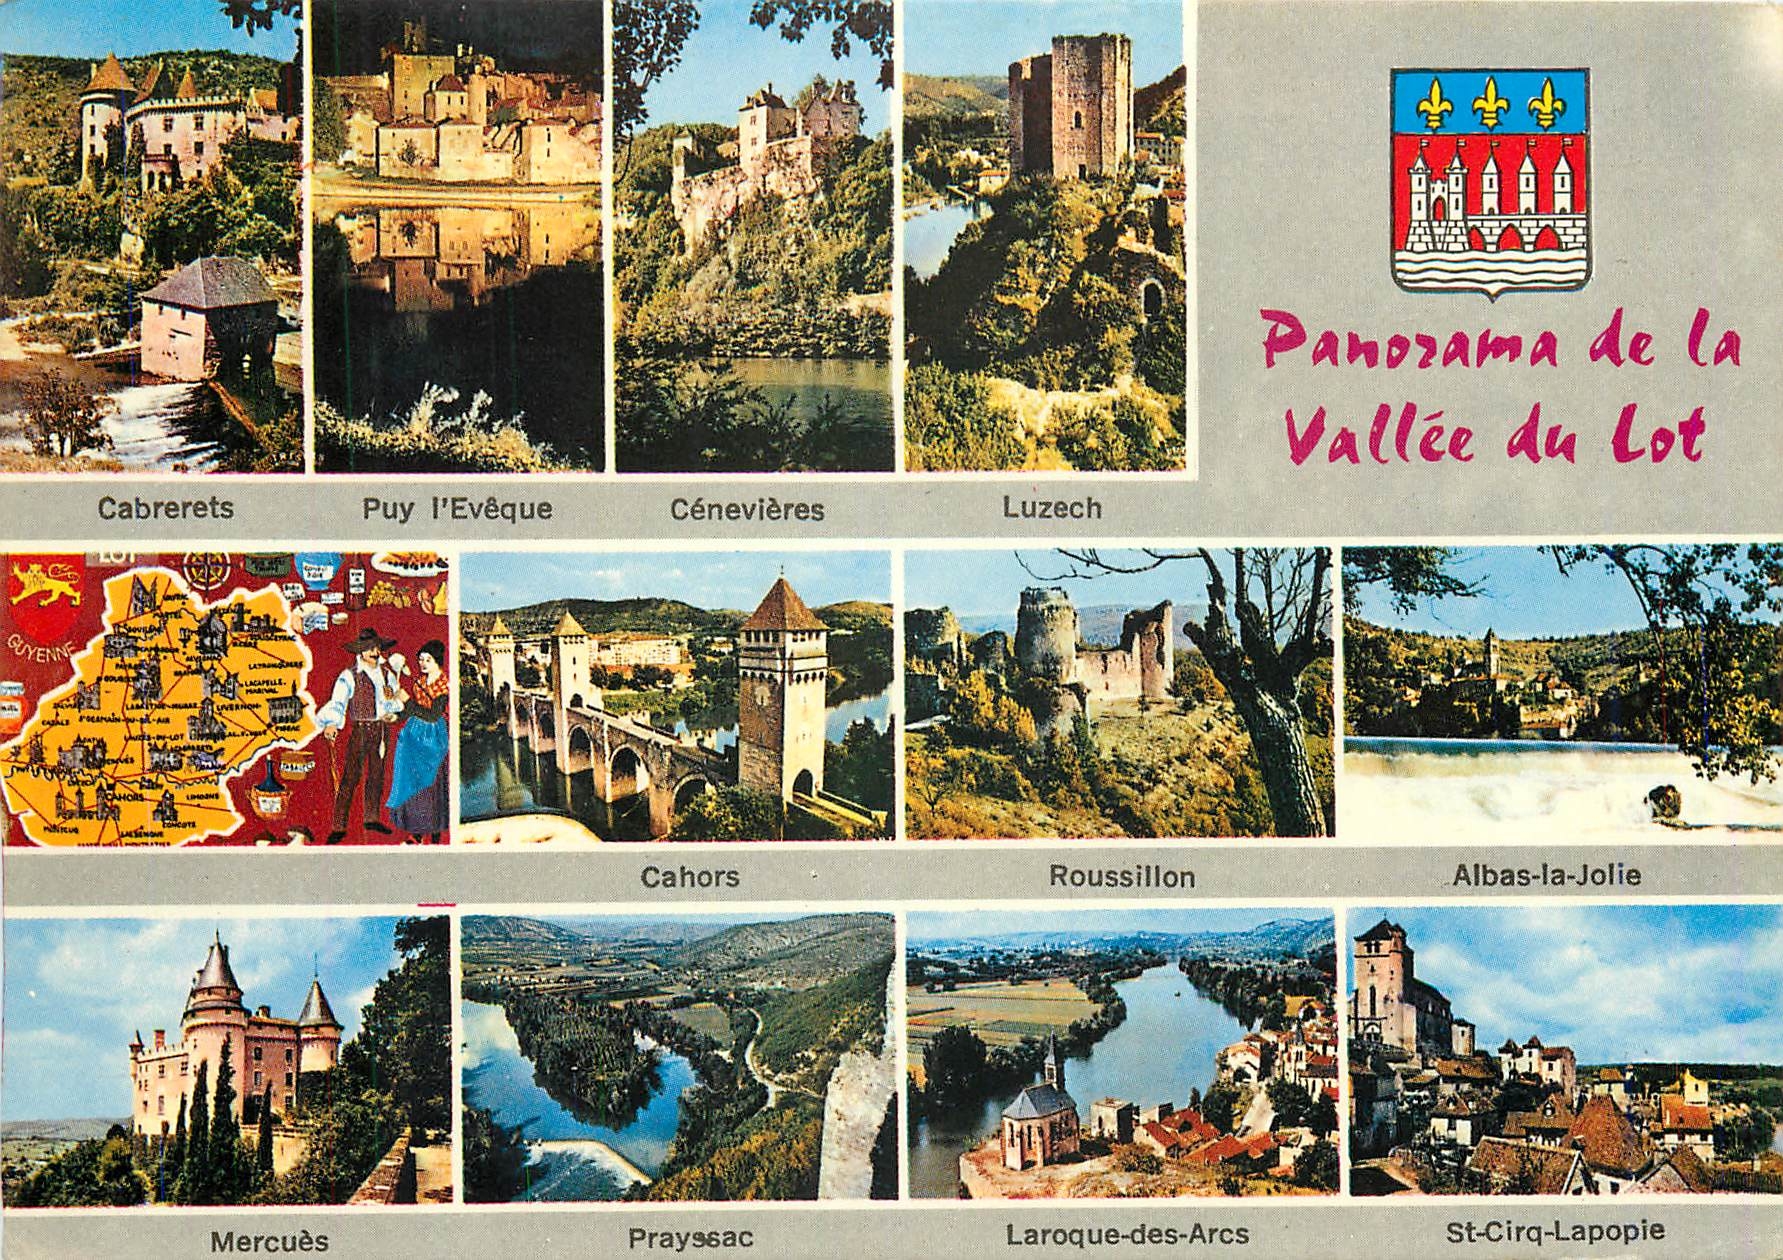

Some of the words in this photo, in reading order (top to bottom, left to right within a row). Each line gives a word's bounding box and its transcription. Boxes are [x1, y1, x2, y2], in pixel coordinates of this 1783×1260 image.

[1261, 310, 1556, 368] Panorama
[1590, 308, 1653, 367] de
[1688, 308, 1740, 366] la
[1286, 403, 1474, 464] Vallée
[1508, 403, 1576, 463] du
[1613, 404, 1705, 463] Lot
[99, 496, 233, 520] Cabrerets
[364, 498, 414, 524] Puy
[433, 497, 552, 525] l'Evêque
[672, 497, 824, 521] Cénevières
[1004, 496, 1101, 519] Luzech
[641, 866, 739, 888] Cahors
[1051, 864, 1194, 888] Roussillon
[1455, 863, 1641, 886] Albas-la-Jolie
[212, 1230, 328, 1252] Mercuès
[630, 1228, 753, 1253] Prayssac
[1007, 1223, 1249, 1248] Laroque-des-Arcs
[1447, 1220, 1664, 1247] St-Cirq-Lapopie
